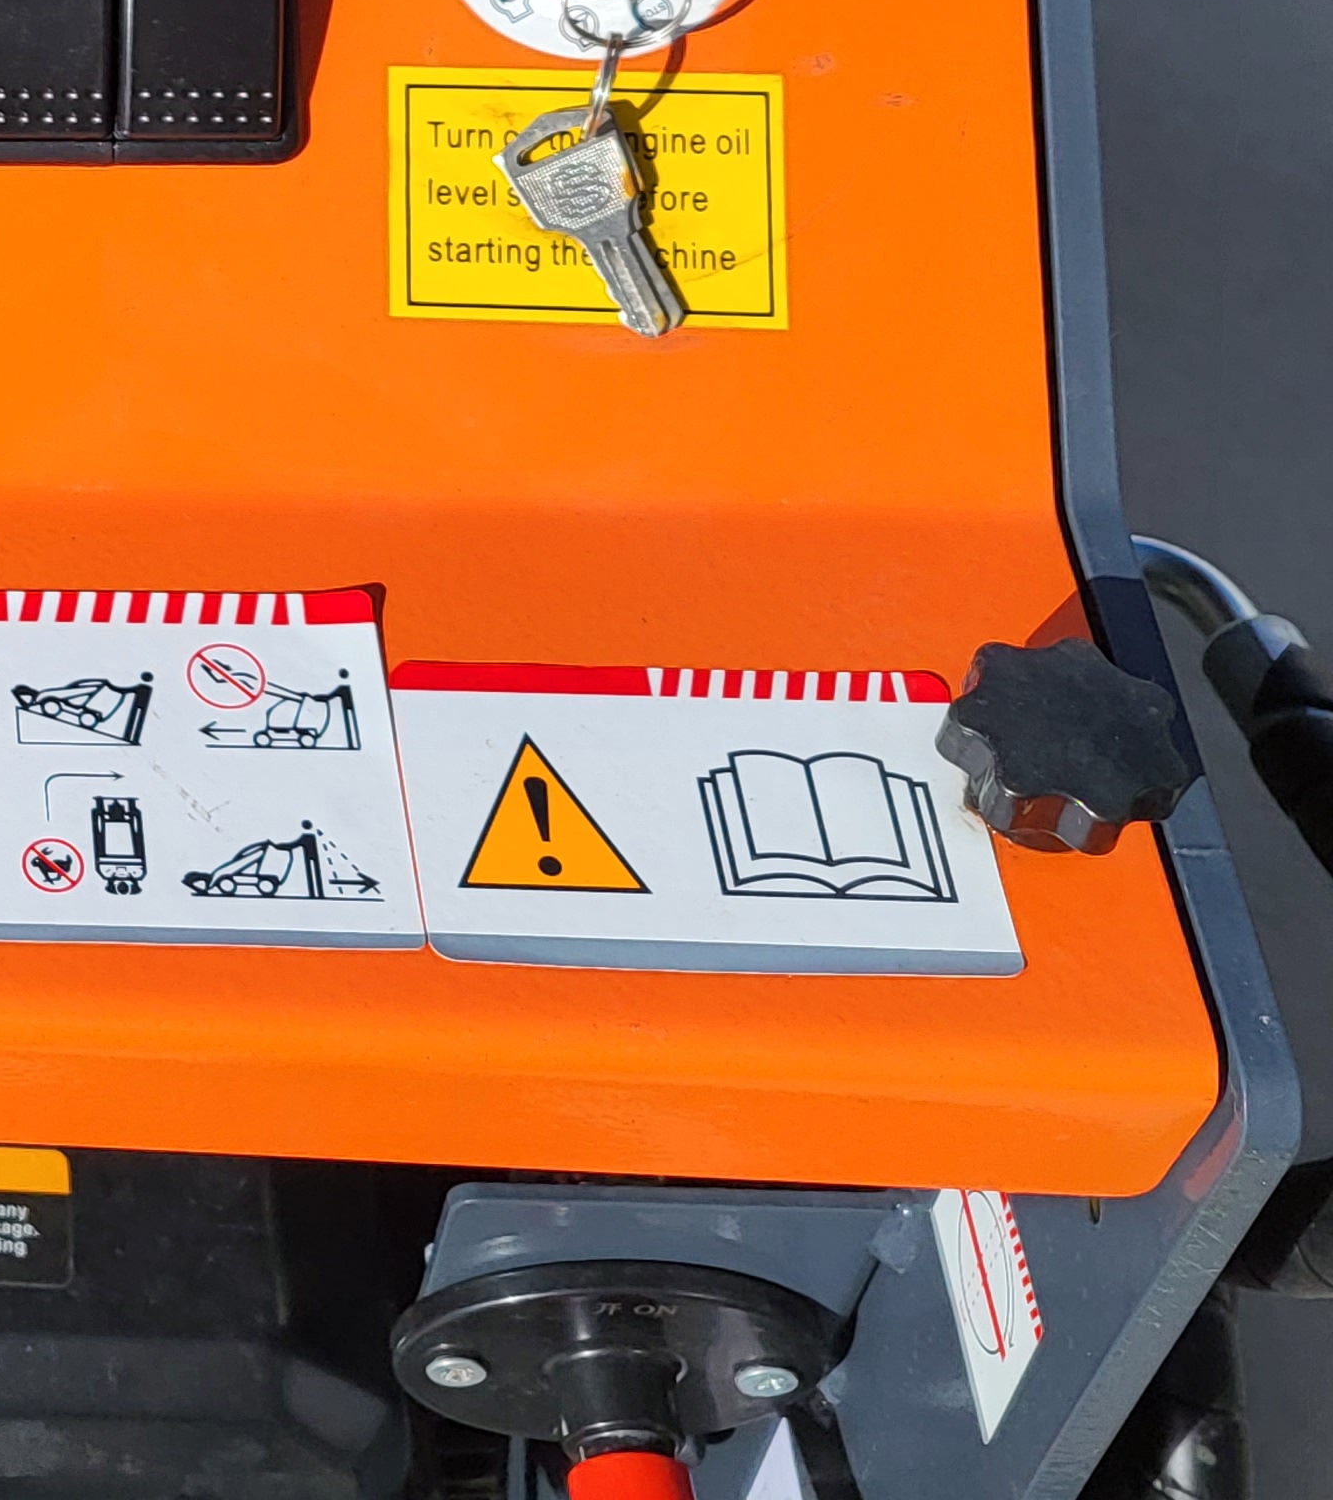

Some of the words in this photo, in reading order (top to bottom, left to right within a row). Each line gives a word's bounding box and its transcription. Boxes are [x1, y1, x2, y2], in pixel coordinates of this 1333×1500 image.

[427, 121, 493, 148] Turn
[627, 127, 706, 160] ngine
[717, 128, 750, 156] oil
[427, 178, 497, 207] level
[427, 236, 541, 272] starting
[654, 240, 737, 271] chine
